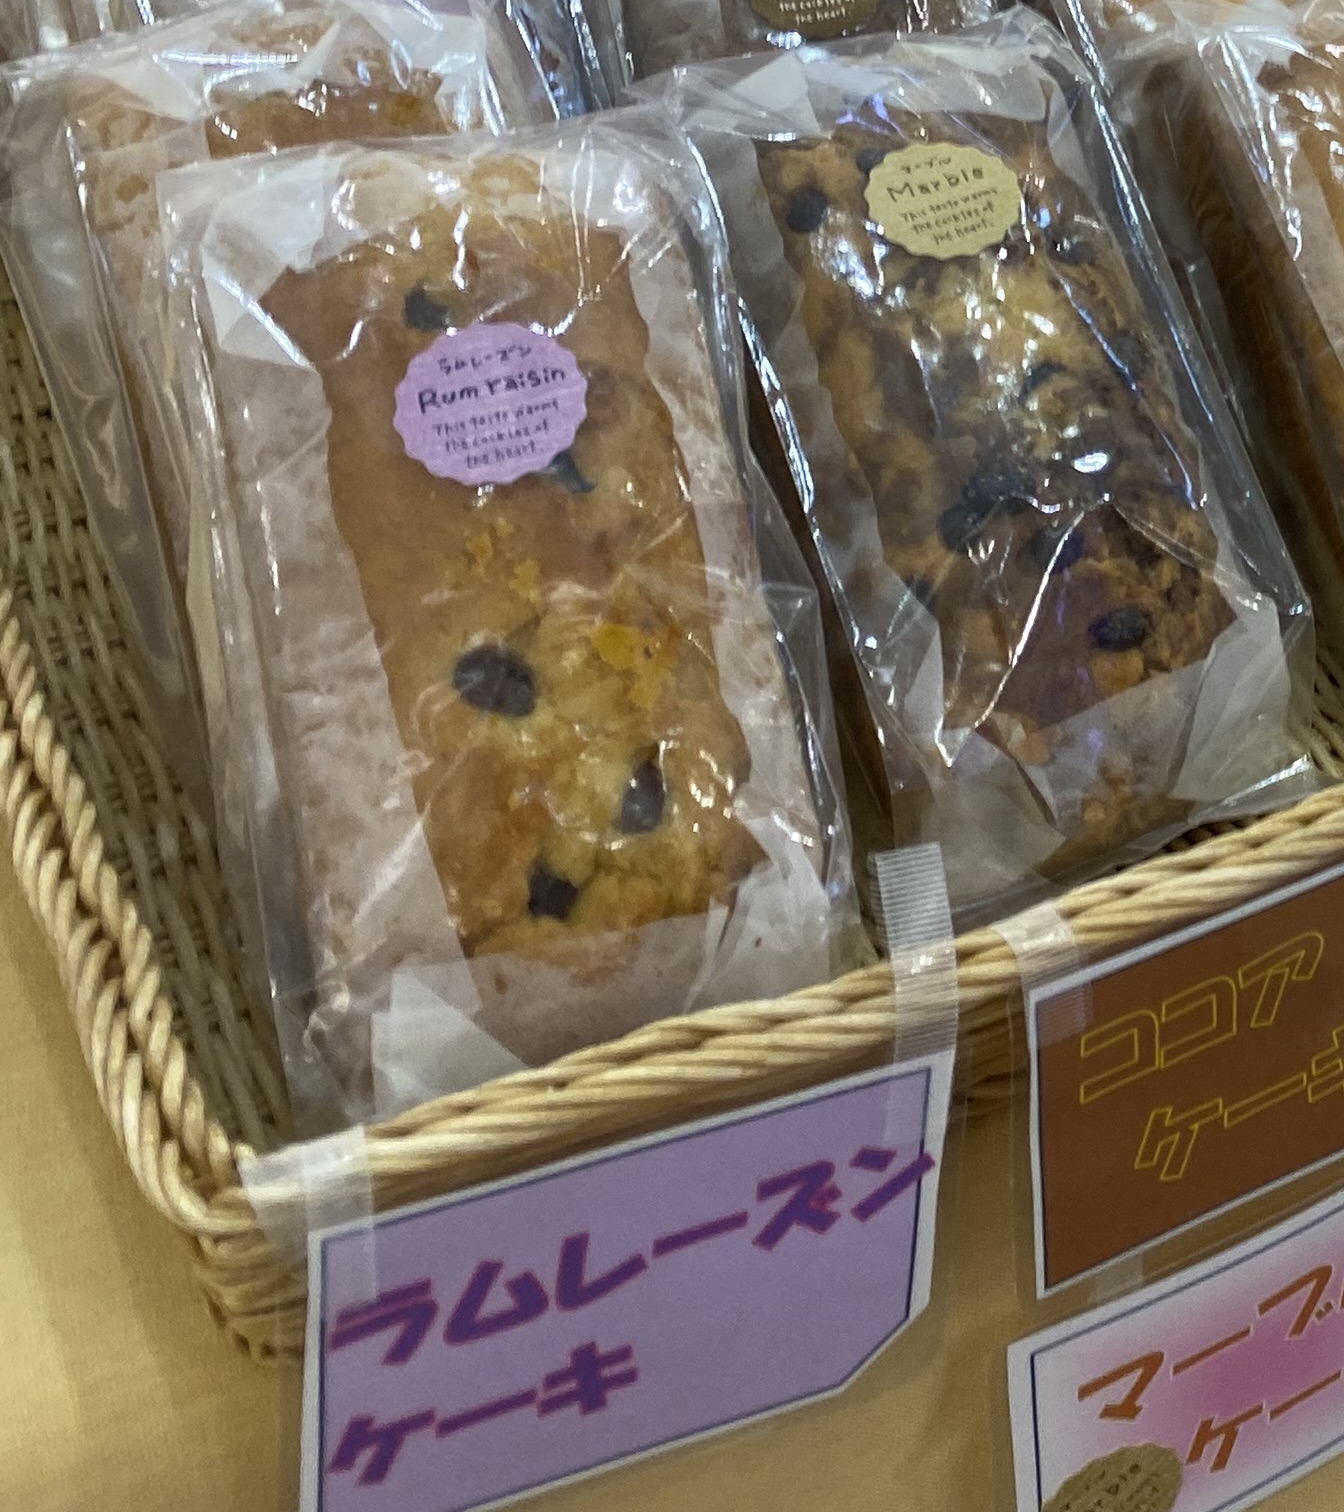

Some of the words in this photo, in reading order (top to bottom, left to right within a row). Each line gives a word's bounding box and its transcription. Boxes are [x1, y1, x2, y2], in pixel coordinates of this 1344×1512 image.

[886, 166, 985, 203] Marble
[418, 384, 479, 414] Rum
[486, 367, 566, 396] raisin
[1079, 931, 1325, 1104] ココア
[328, 1144, 934, 1364] ラムレーズン
[328, 1341, 639, 1486] ケーキ
